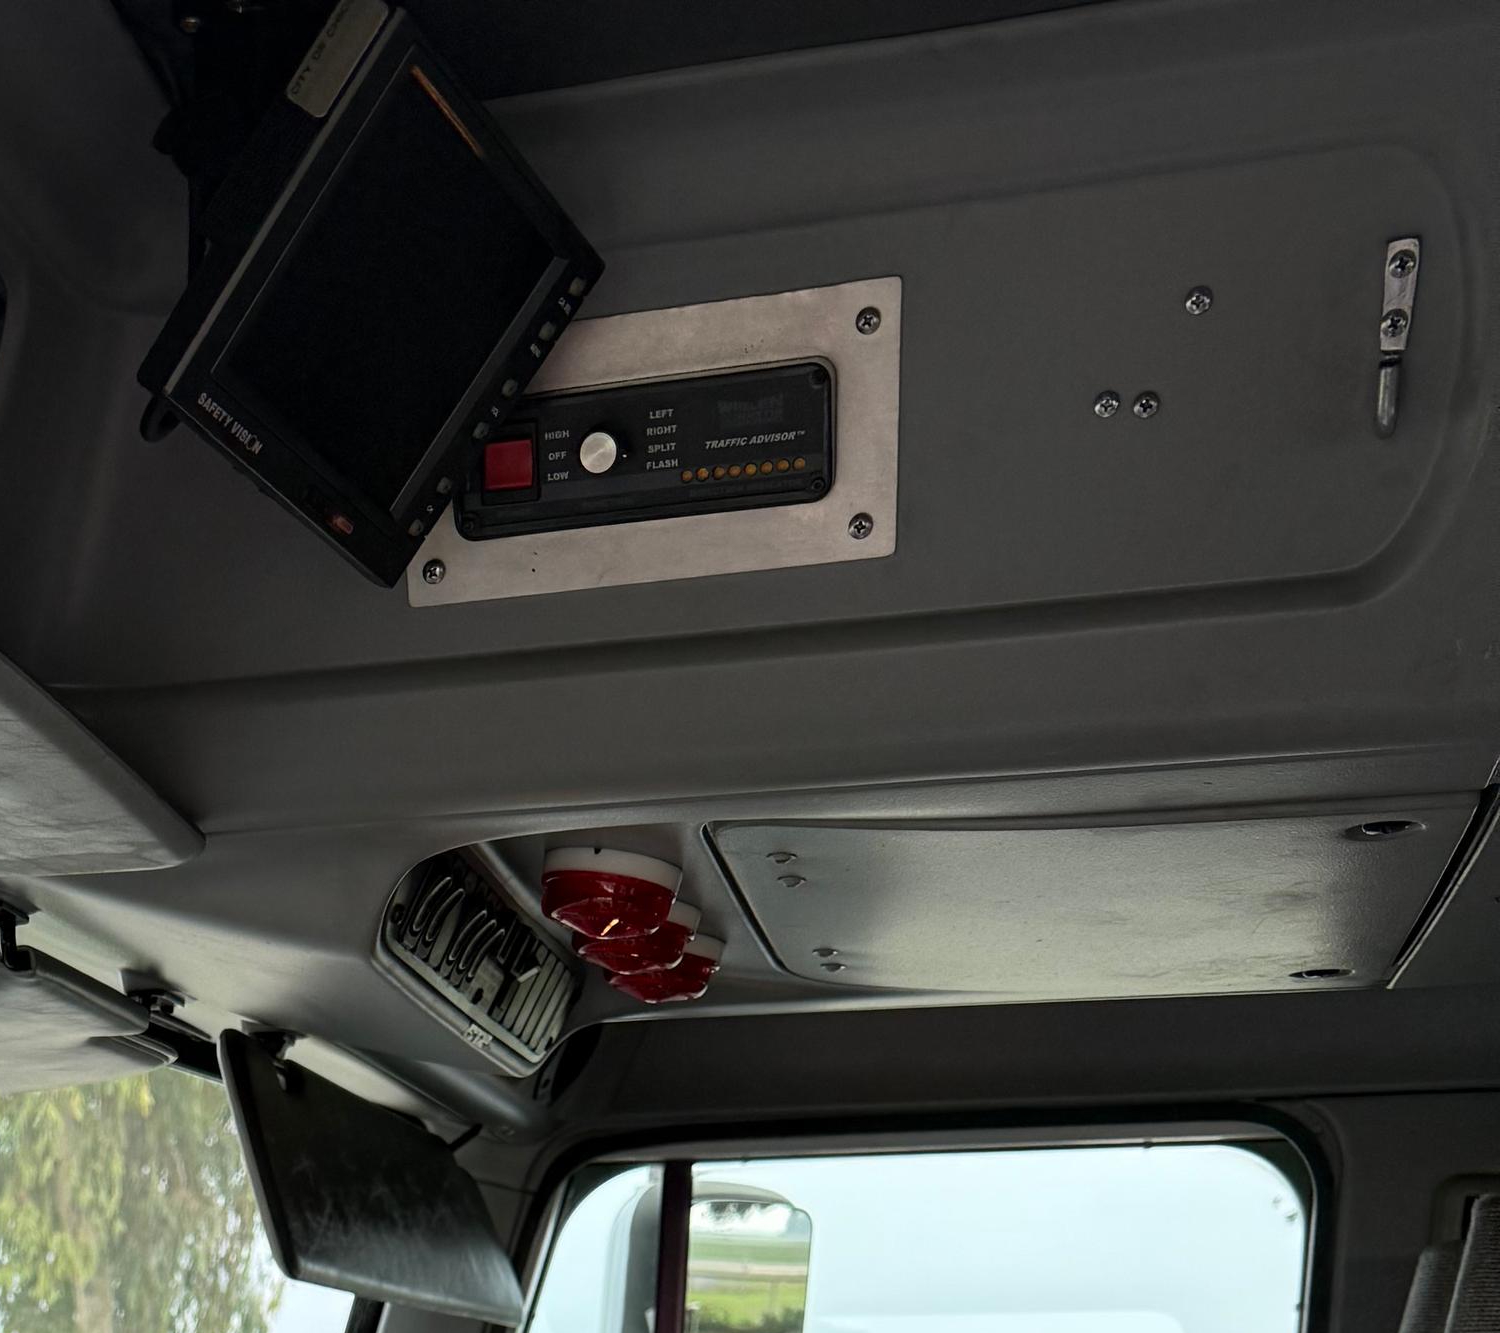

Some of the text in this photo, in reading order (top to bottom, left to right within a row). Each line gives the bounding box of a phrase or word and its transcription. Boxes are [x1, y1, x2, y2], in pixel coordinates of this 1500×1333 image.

[648, 407, 675, 421] LEFT
[196, 391, 265, 456] SAFETY VISION
[544, 428, 571, 441] HIGH
[646, 424, 679, 438] RIGHT
[647, 441, 677, 455] SPLIT
[704, 436, 748, 451] TRAFFIC
[548, 450, 569, 463] OFF
[645, 457, 679, 471] FLASH
[546, 469, 571, 483] LOW
